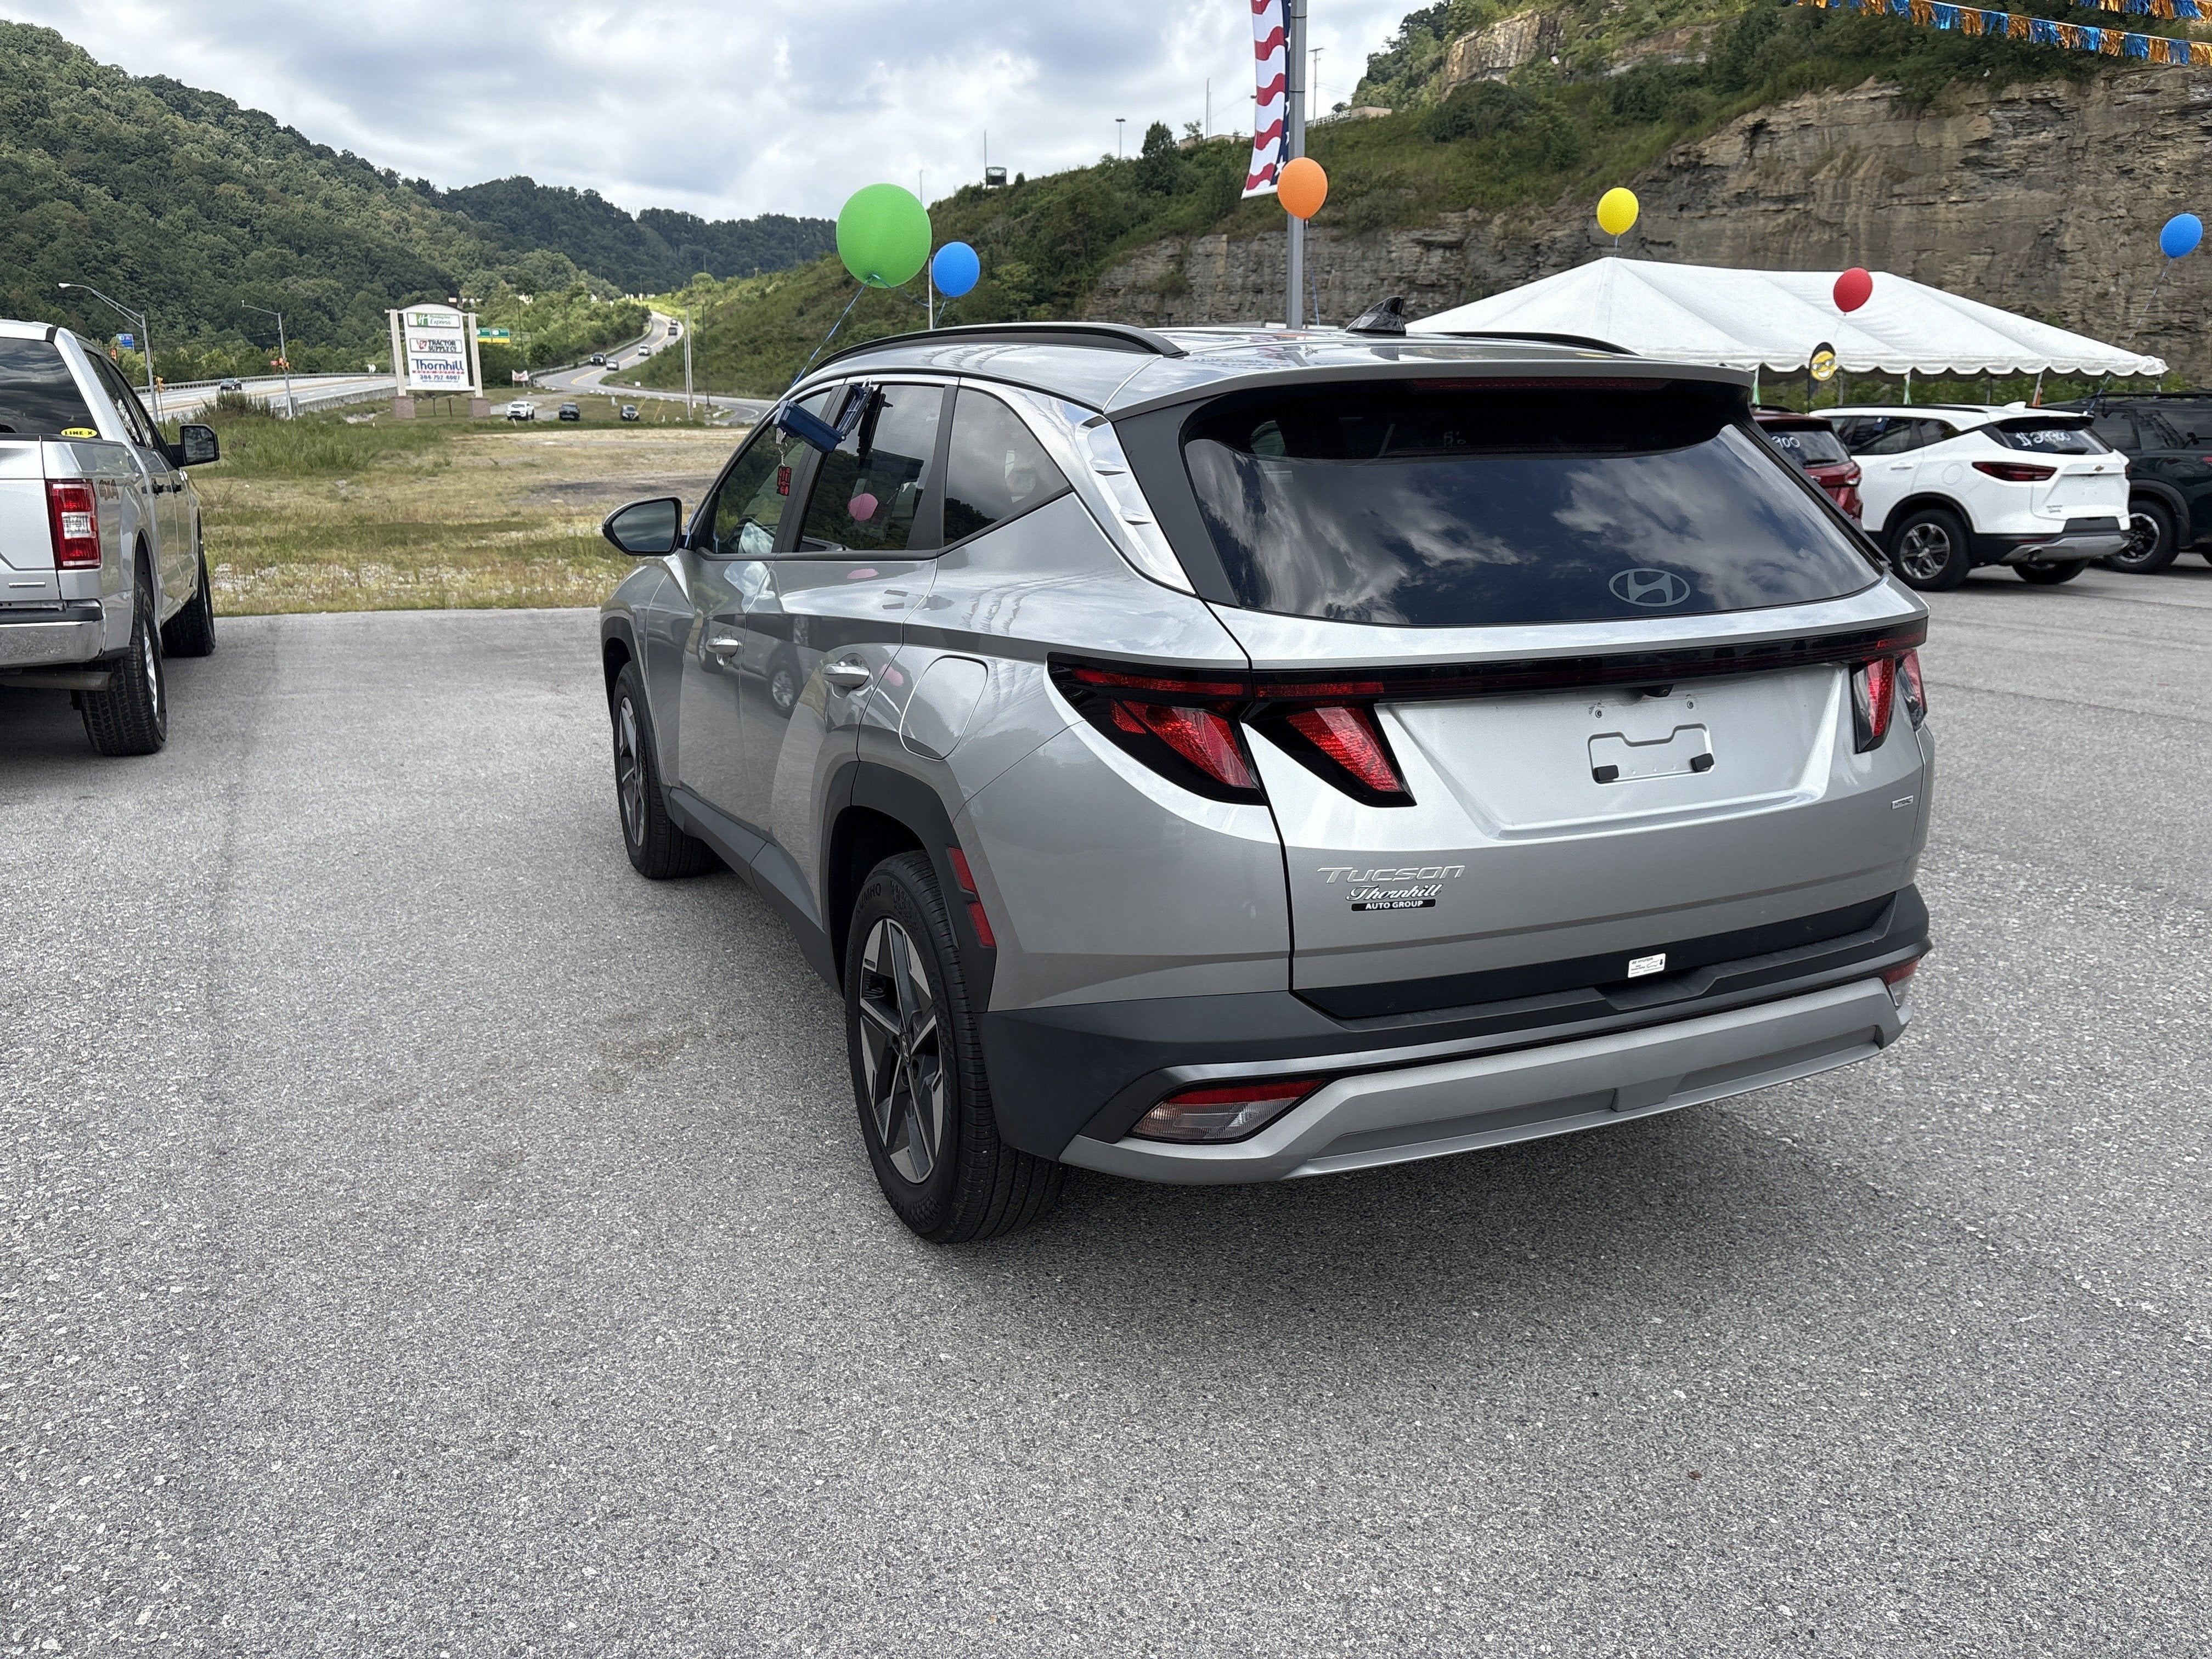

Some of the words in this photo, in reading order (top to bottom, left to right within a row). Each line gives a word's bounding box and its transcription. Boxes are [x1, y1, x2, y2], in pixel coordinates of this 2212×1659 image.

[411, 358, 464, 370] Thornhill
[1345, 883, 1443, 901] Thornhill
[1365, 902, 1392, 910] AUTO
[1392, 900, 1424, 909] GROUP
